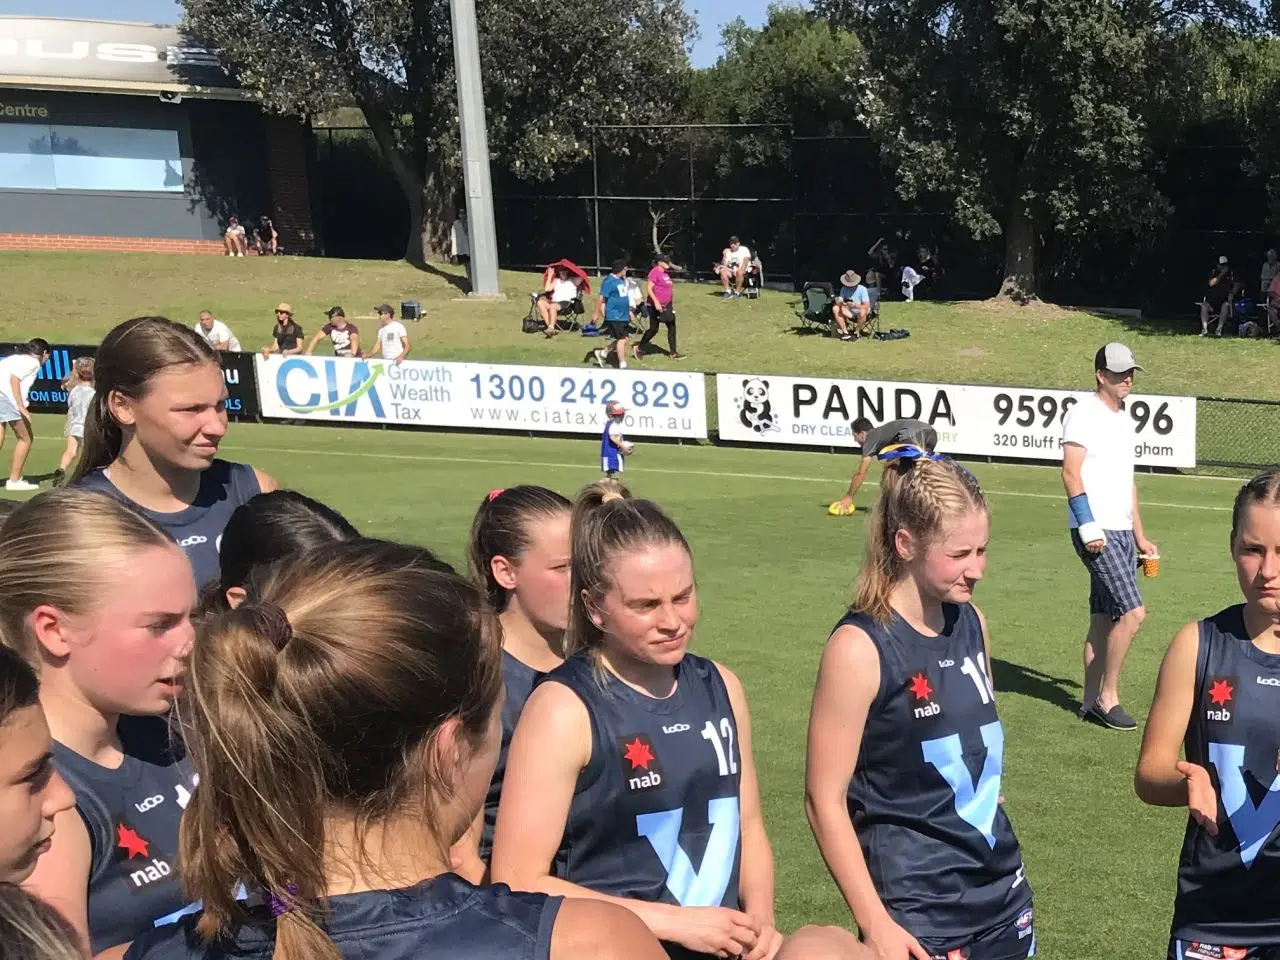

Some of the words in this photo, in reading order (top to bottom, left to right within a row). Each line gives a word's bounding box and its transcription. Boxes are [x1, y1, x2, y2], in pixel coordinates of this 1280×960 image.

[388, 363, 452, 382] Growth
[276, 358, 386, 418] CIA
[389, 383, 451, 402] Wealth
[470, 373, 545, 401] 1300
[560, 377, 616, 405] 242
[632, 380, 689, 409] 829
[391, 403, 421, 420] Tax
[792, 384, 956, 426] PANDA
[792, 424, 815, 435] DRY
[993, 434, 1017, 447] 320
[1022, 435, 1054, 449] Bluff
[914, 702, 941, 719] nab
[1206, 708, 1231, 722] nab
[701, 717, 738, 776] 12
[628, 772, 661, 790] nab
[130, 858, 171, 887] nab
